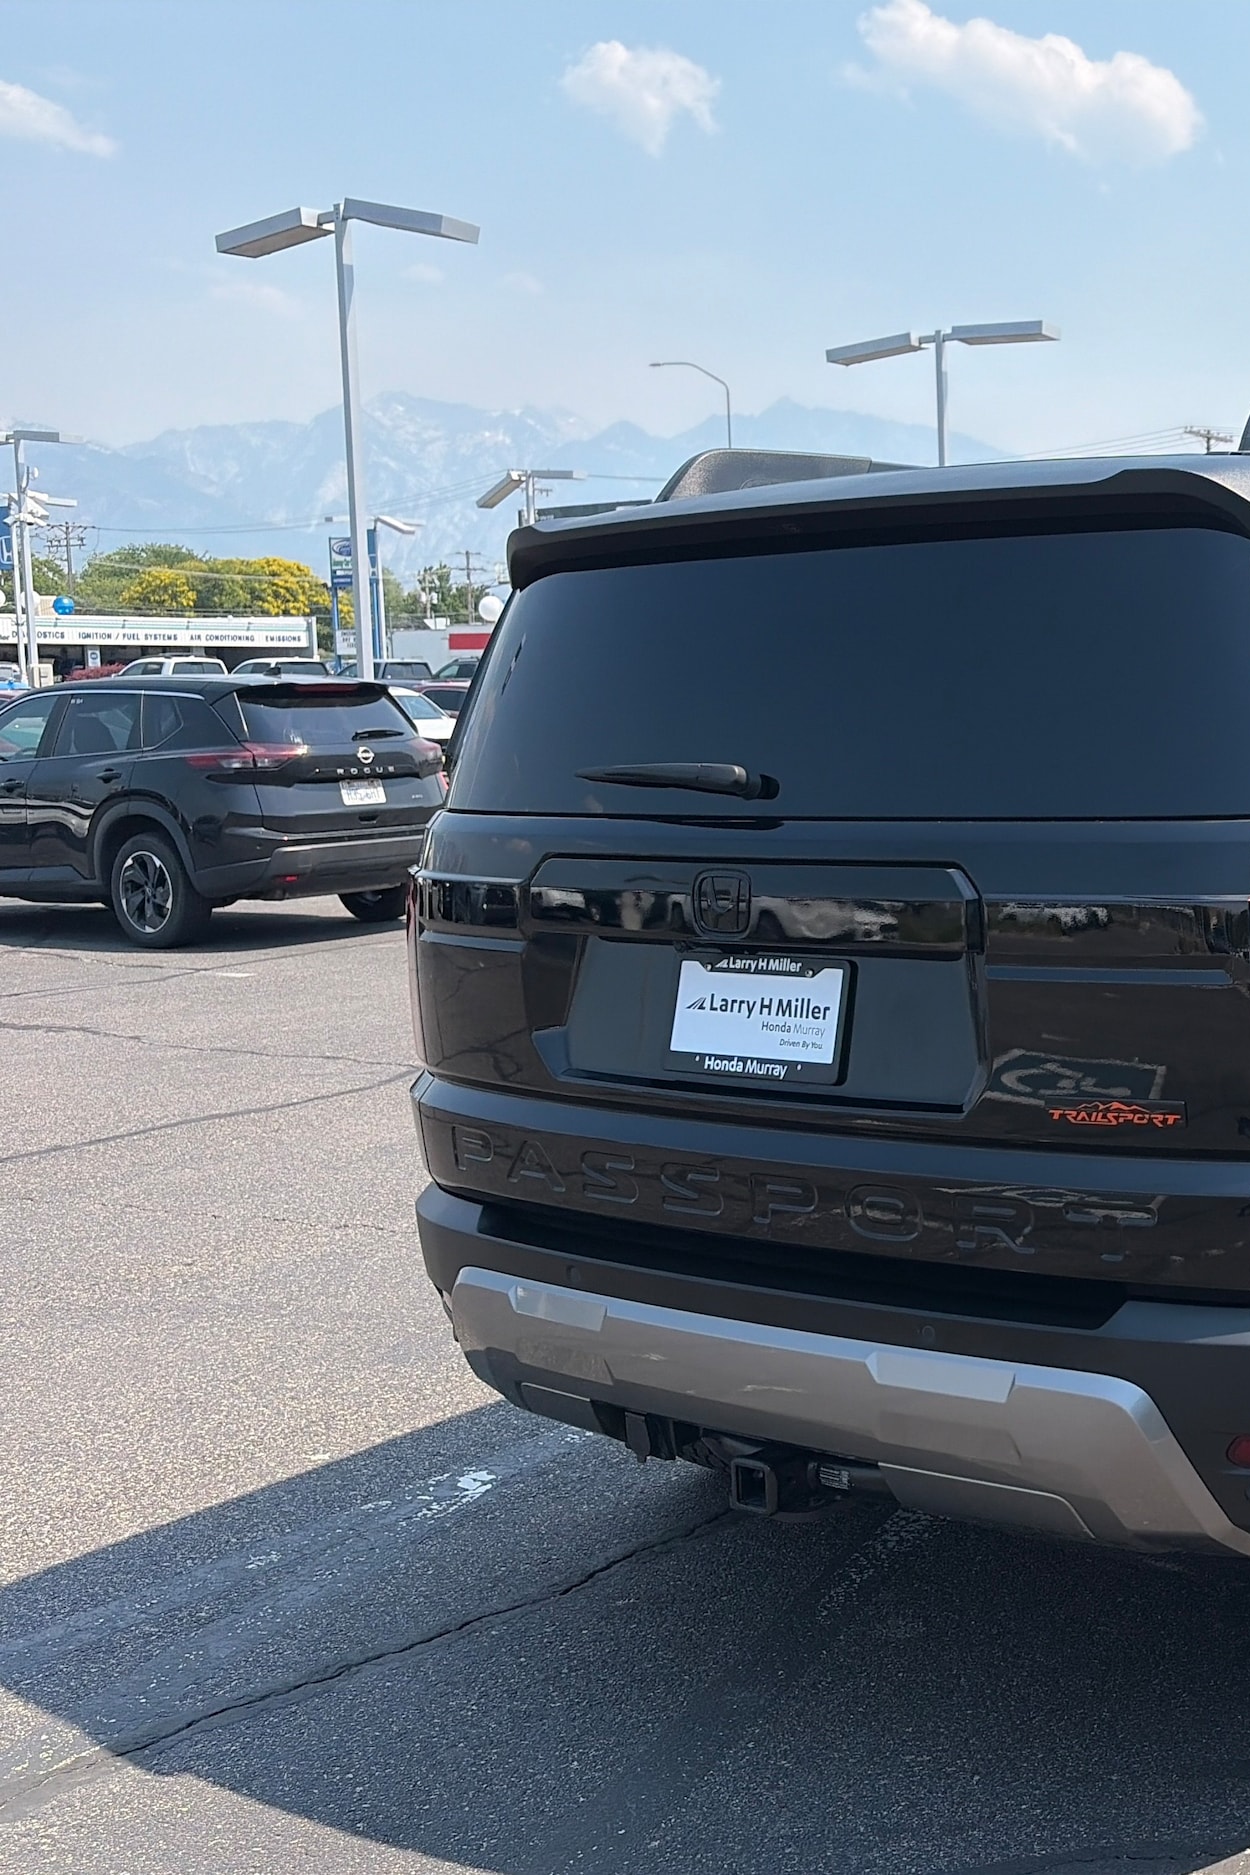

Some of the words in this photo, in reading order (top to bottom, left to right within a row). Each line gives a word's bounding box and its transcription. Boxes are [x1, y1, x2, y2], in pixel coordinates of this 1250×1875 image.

[11, 631, 65, 639] DOSTICS
[78, 632, 112, 640] IGNITION
[122, 633, 140, 641] FUEL
[144, 633, 178, 641] SYSTEMS
[190, 634, 202, 642] AIR
[205, 634, 255, 643] CONDITIONING
[265, 635, 302, 643] EMISSIONS
[336, 766, 395, 775] ROGUE
[729, 956, 757, 972] Larry
[758, 959, 769, 971] H
[769, 959, 802, 973] Miller
[709, 993, 757, 1019] Larry
[759, 997, 772, 1016] H
[776, 997, 831, 1021] Miller
[761, 1021, 792, 1034] Honda
[793, 1023, 826, 1038] Murray
[779, 1038, 801, 1048] Driven
[801, 1040, 810, 1050] By
[703, 1055, 744, 1073] Honda
[744, 1059, 788, 1080] Murray
[1048, 1109, 1182, 1127] TRAILSPORT
[451, 1125, 1160, 1263] PASSPORT
